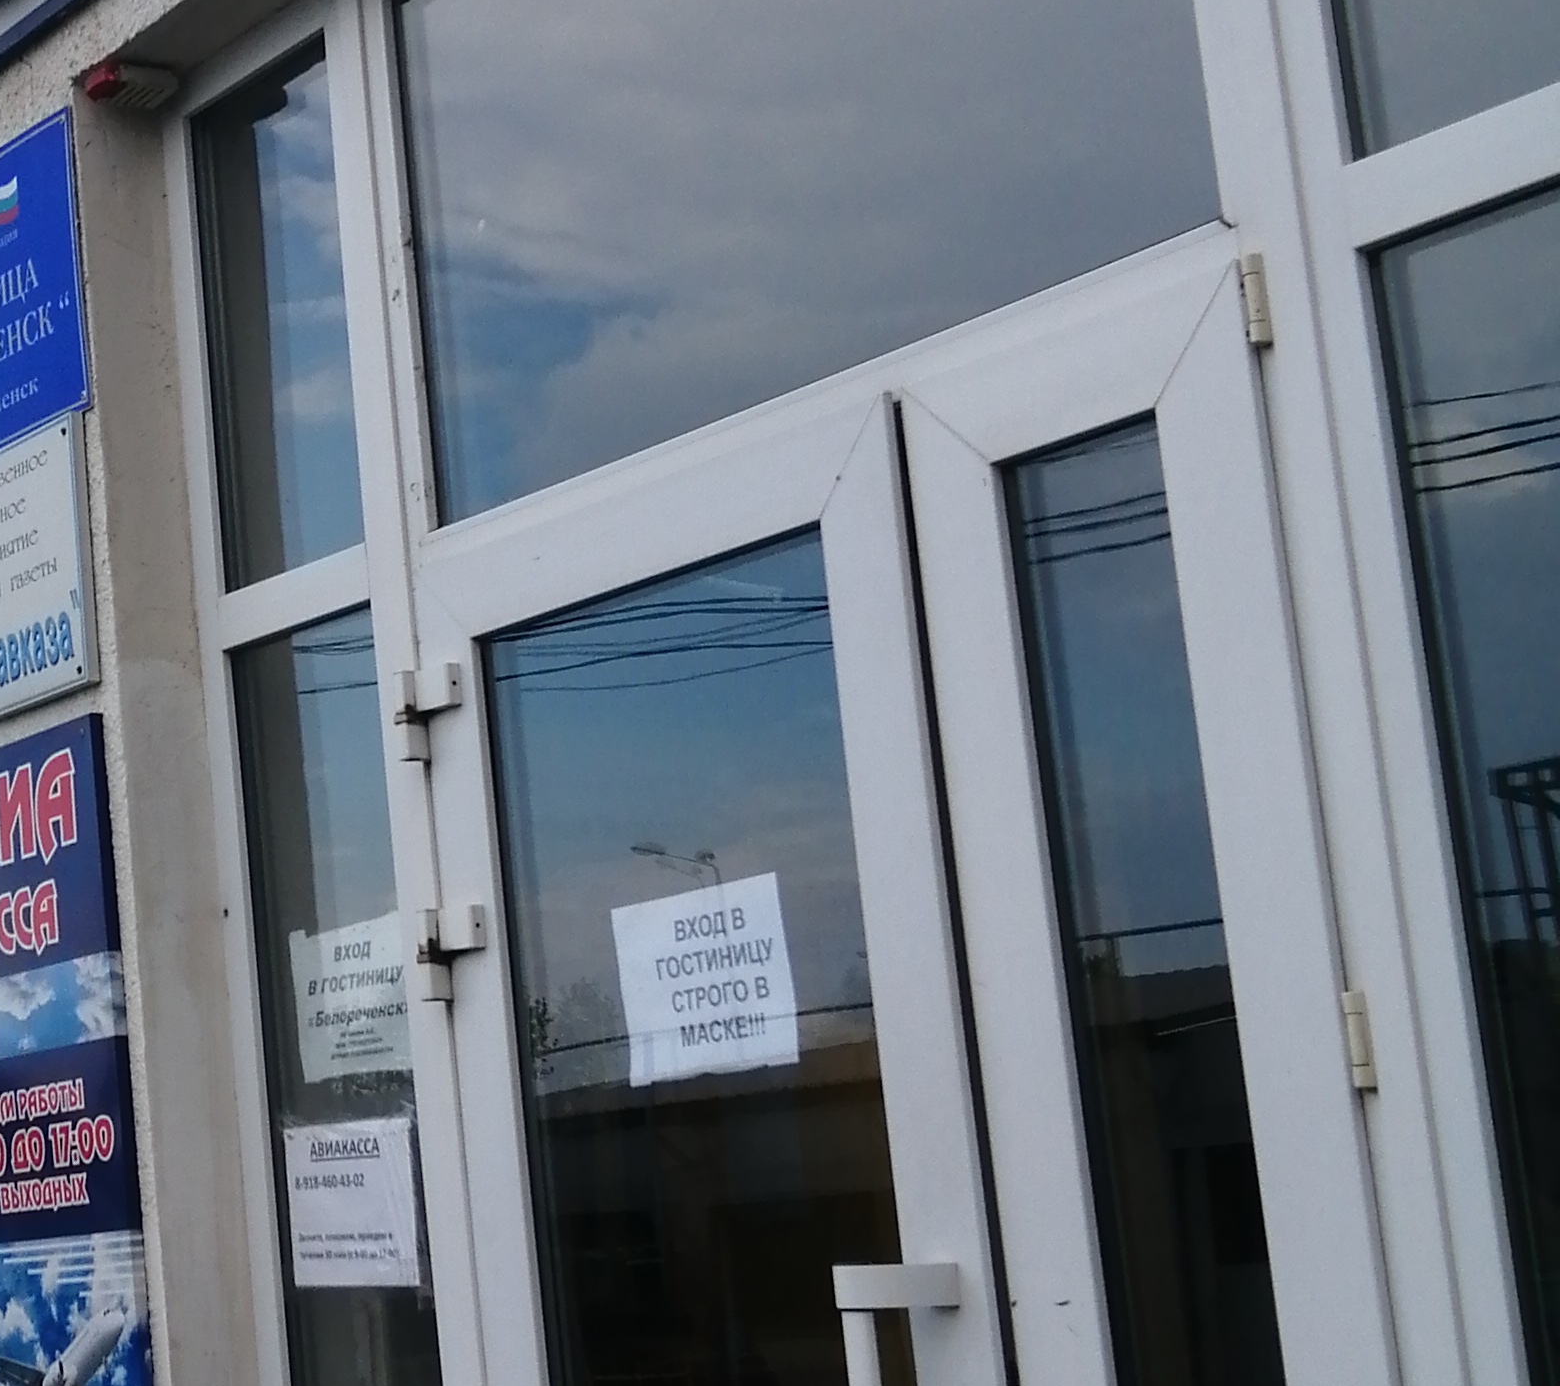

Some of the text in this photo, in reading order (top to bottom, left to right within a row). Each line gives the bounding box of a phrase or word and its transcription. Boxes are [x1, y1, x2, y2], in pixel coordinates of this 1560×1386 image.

[10, 558, 57, 594] газеты
[673, 907, 746, 942] ВХОД В
[334, 940, 371, 962] ВХОД
[655, 937, 774, 982] ГОСТИНИЦУ
[308, 965, 404, 996] В ГОСТИНИЦУ
[671, 977, 770, 1013] СТРОГО В
[679, 1012, 767, 1049] МАСКЕ!!!
[18, 1078, 83, 1122] РАБОТЫ
[10, 1123, 44, 1179] ДО
[51, 1115, 114, 1167] 17:00
[310, 1137, 380, 1162] АВИАКАССА
[0, 1172, 89, 1214] ВЫХОДНЫХ
[295, 1173, 365, 1191] 8-918-460-43-02
